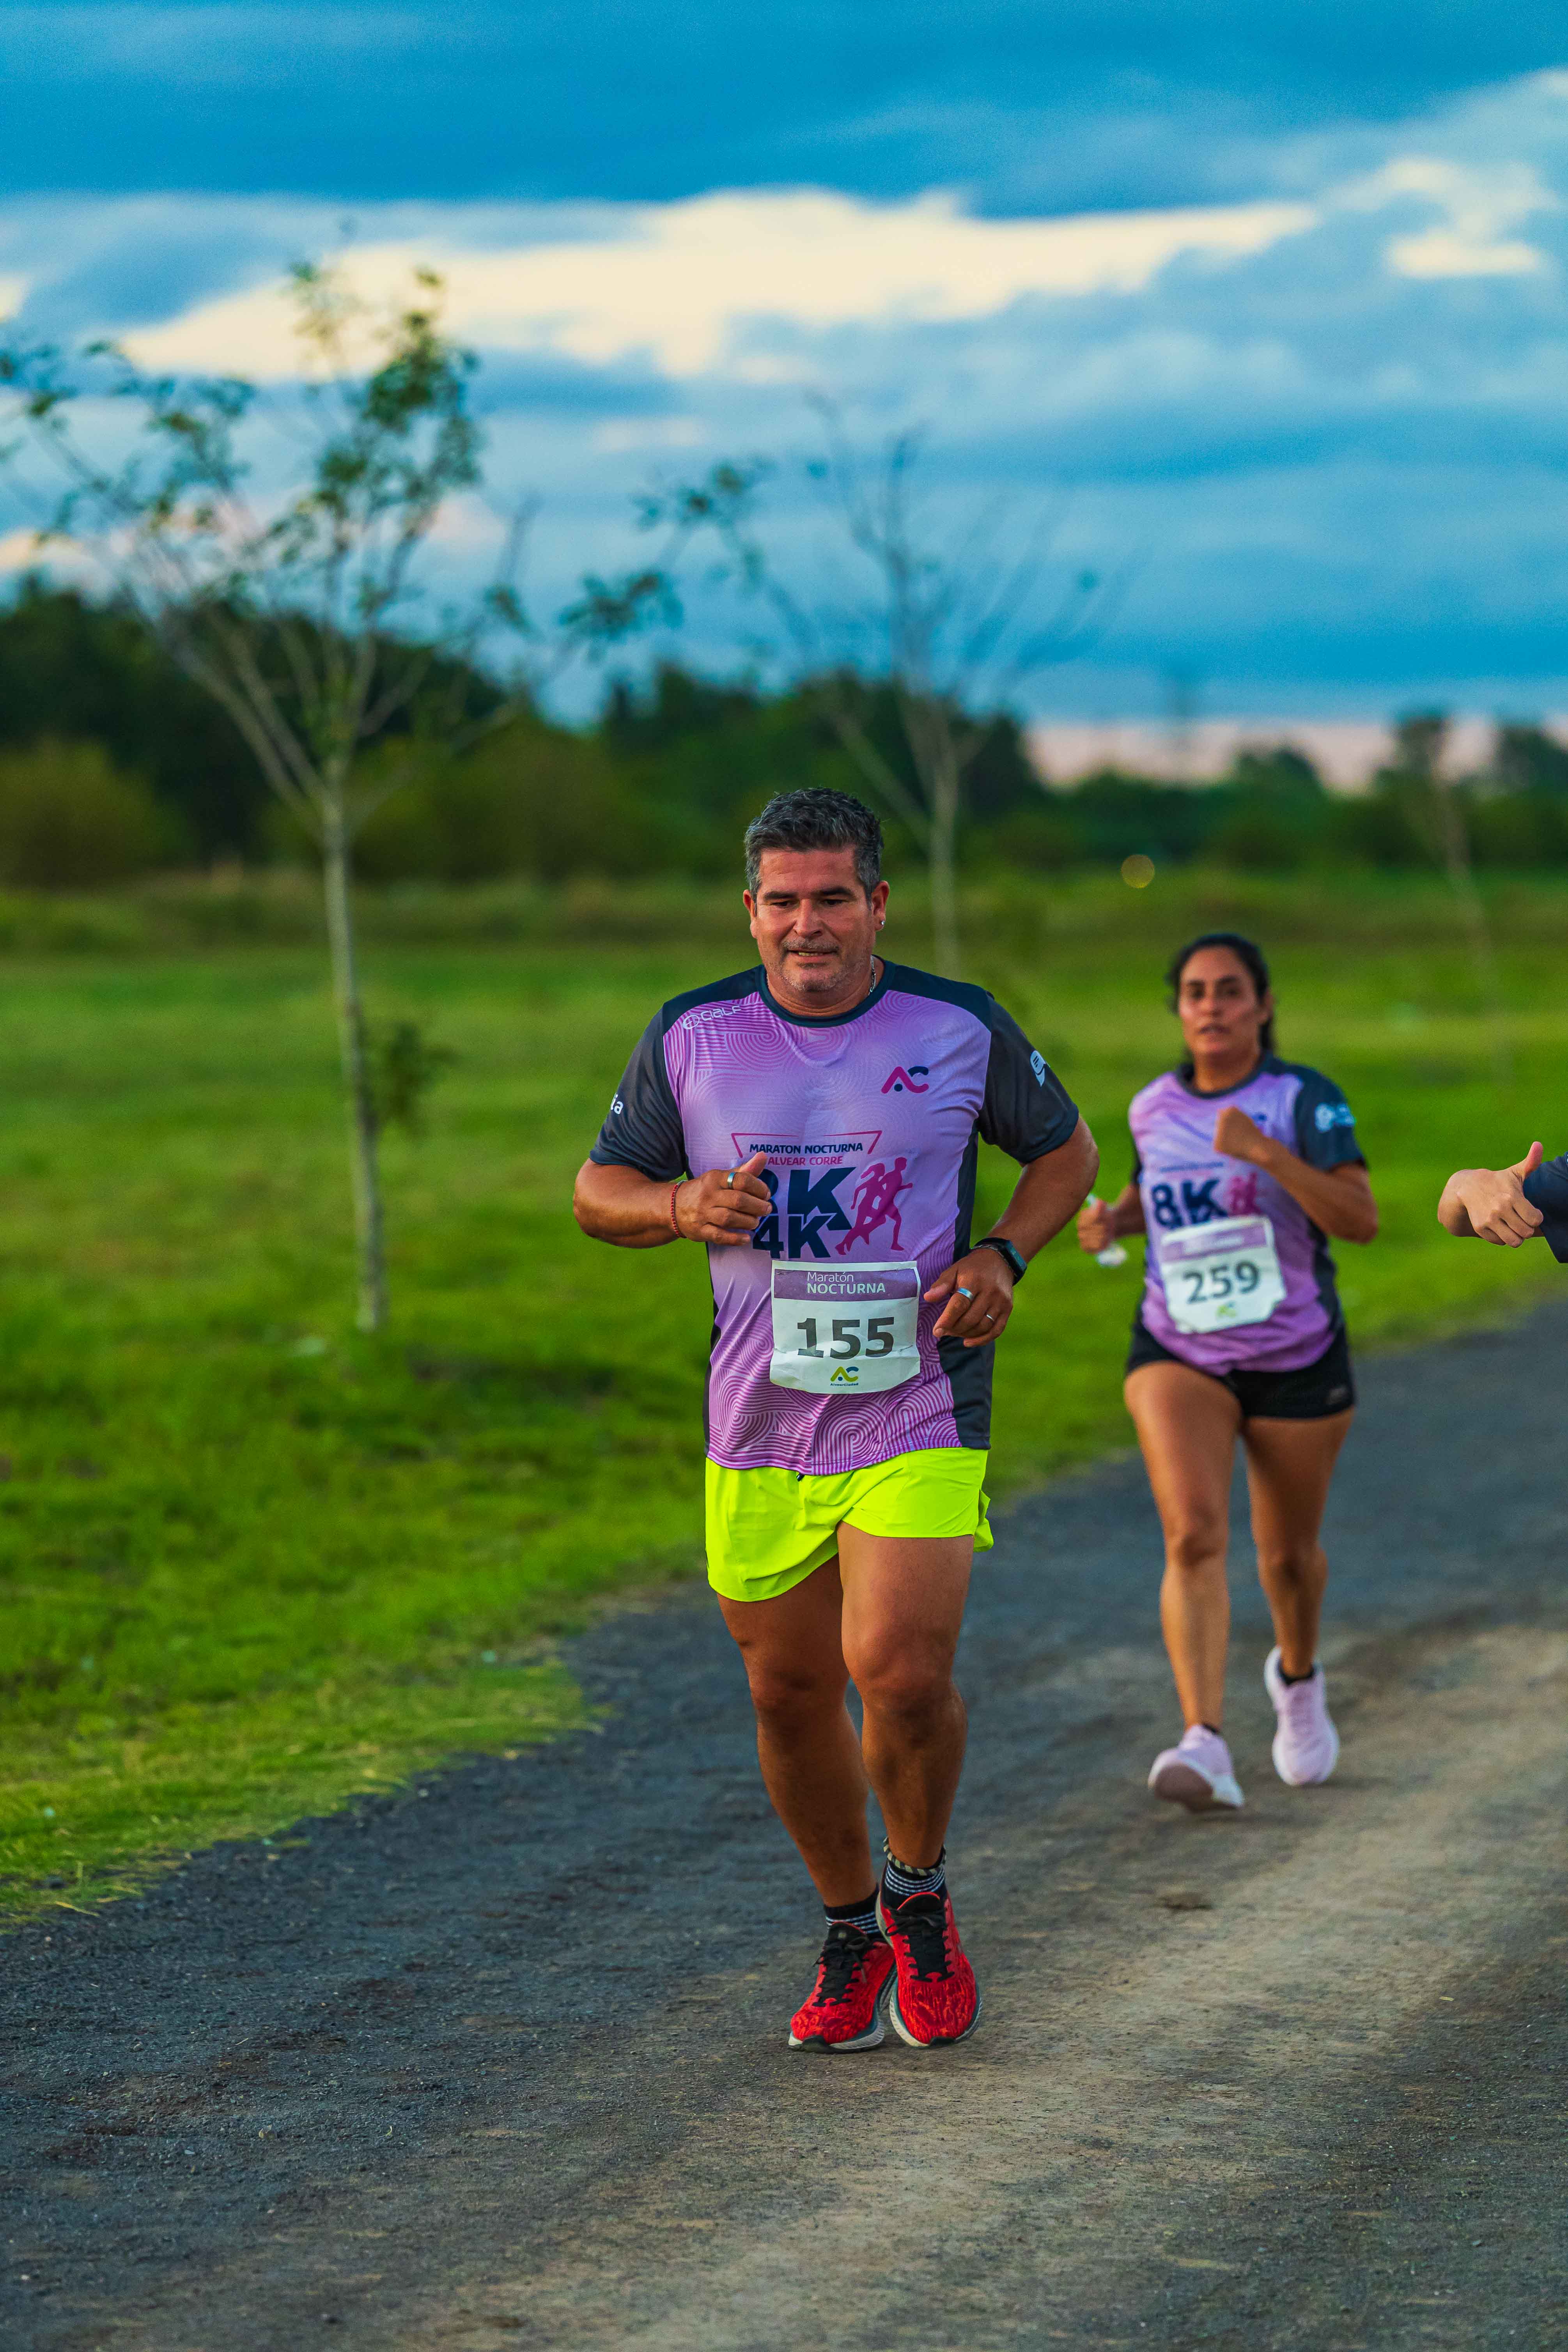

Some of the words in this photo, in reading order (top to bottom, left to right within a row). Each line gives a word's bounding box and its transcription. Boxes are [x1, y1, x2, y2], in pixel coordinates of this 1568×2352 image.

[749, 1144, 801, 1154] MARATON
[804, 1142, 863, 1154] NOCTURNA
[767, 1156, 806, 1165] ALVEAR
[809, 1155, 843, 1165] CORRE
[1152, 1179, 1228, 1227] 8K
[752, 1215, 831, 1259] 4K
[807, 1272, 854, 1282] Maratón
[807, 1282, 886, 1295] NOCTURNA
[1182, 1260, 1260, 1304] 259
[797, 1316, 895, 1360] 155
